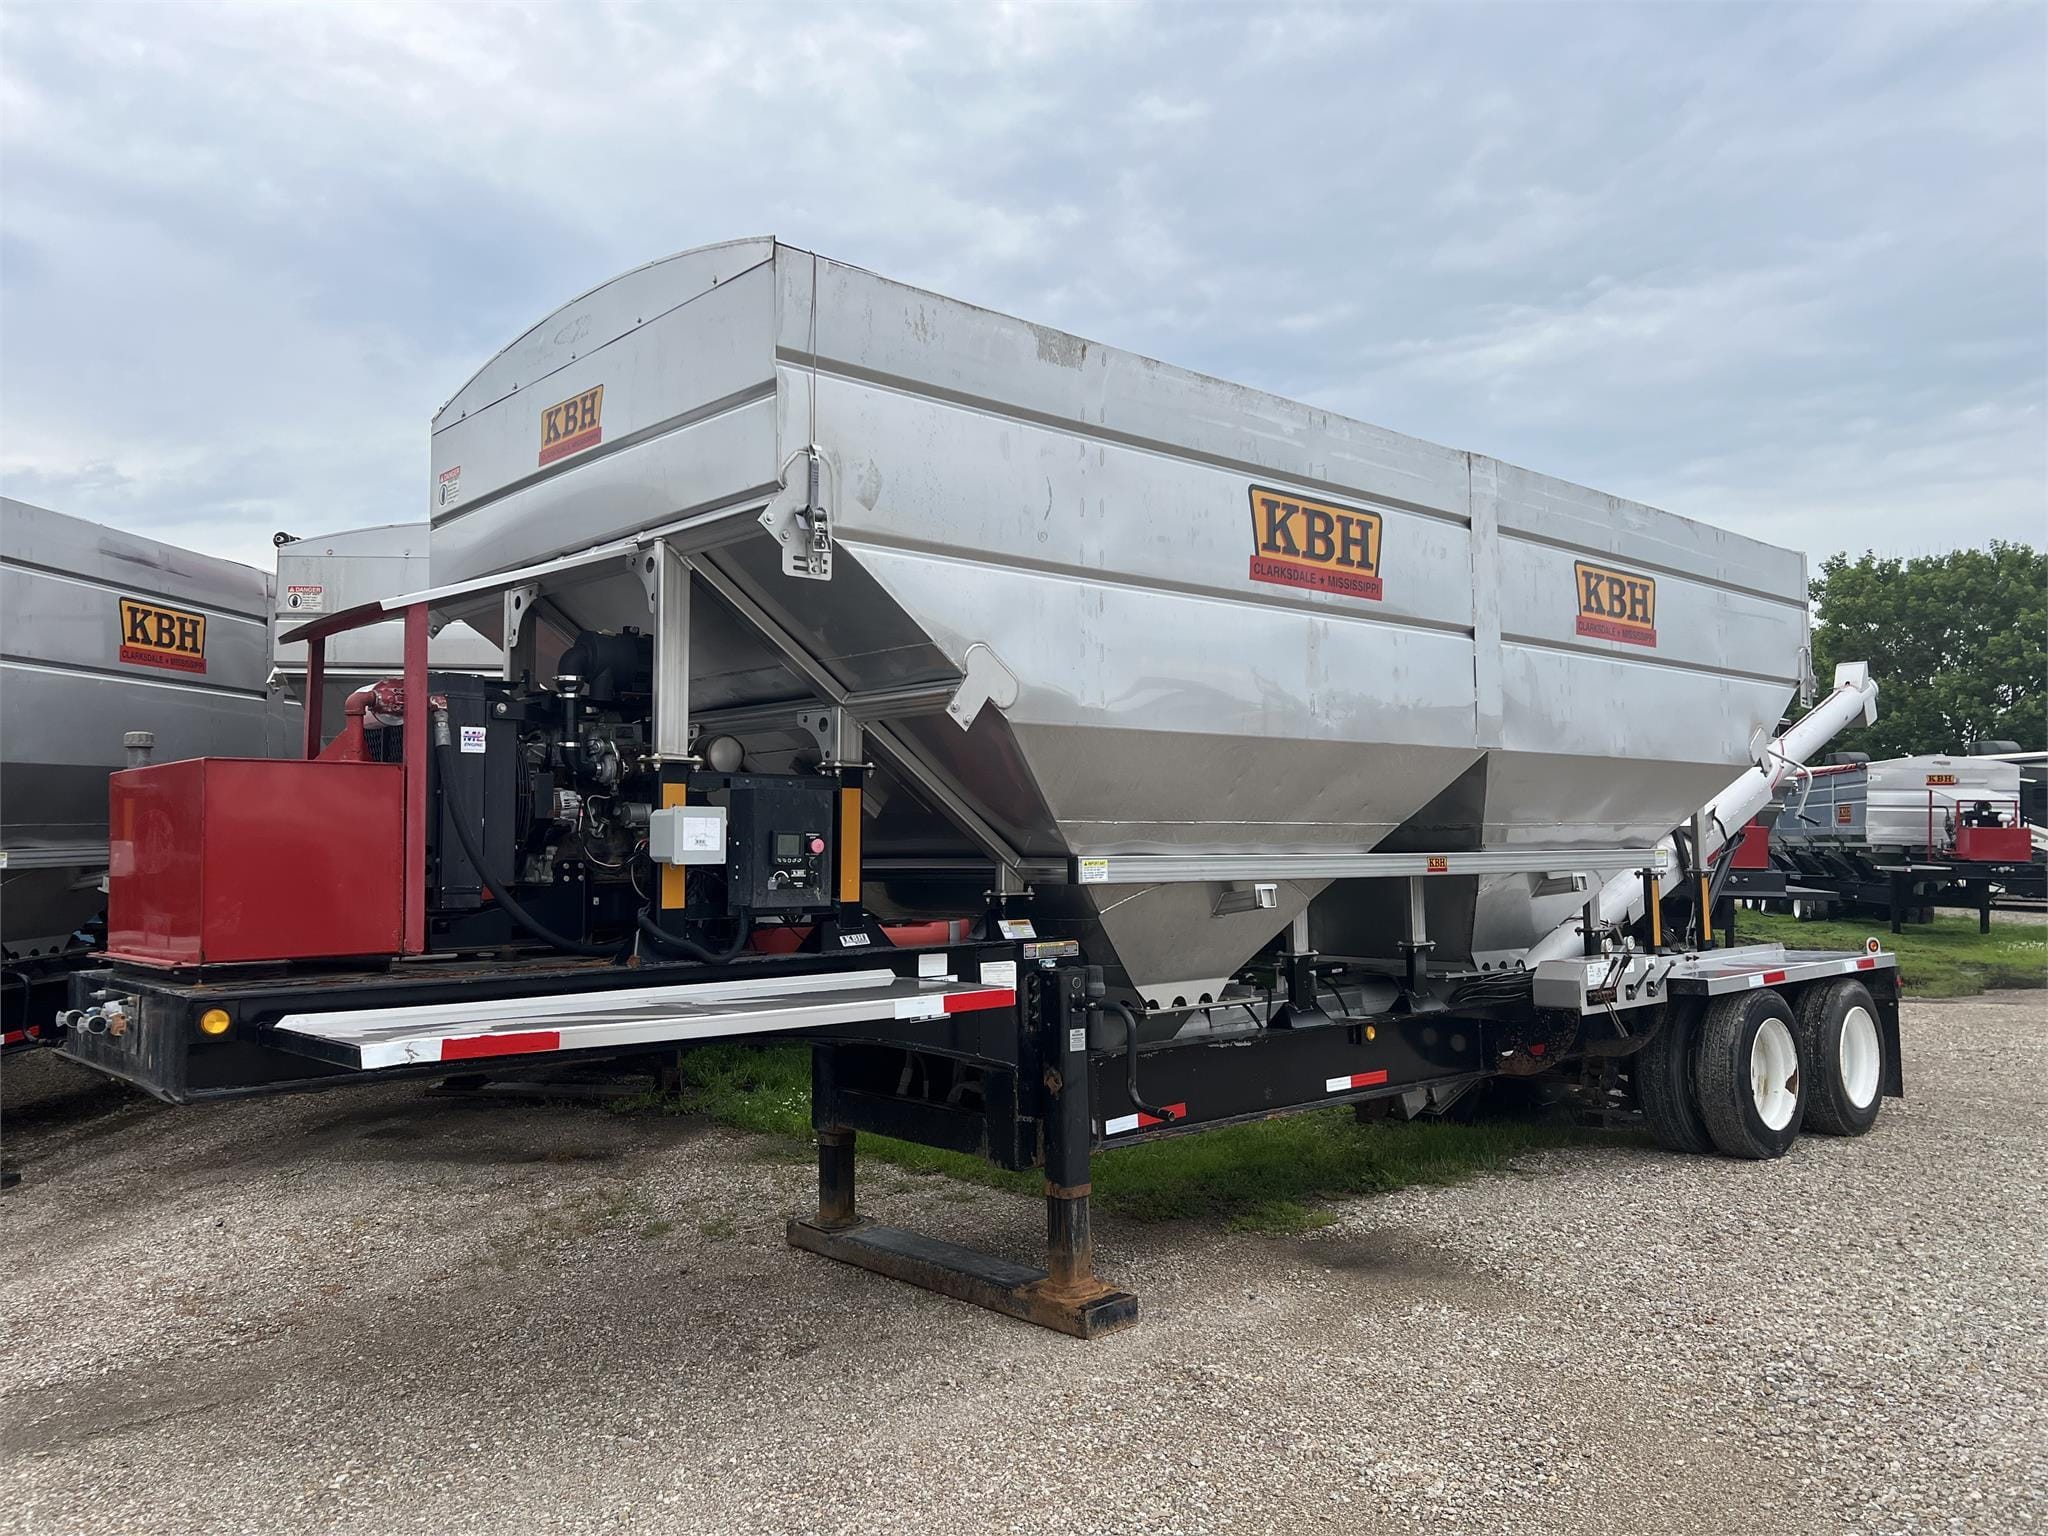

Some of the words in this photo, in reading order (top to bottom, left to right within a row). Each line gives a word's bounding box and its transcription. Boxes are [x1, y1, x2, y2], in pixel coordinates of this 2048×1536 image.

[544, 390, 598, 446] KBH
[1261, 498, 1374, 570] KBH
[1253, 562, 1317, 584] CLARKSDALE
[1327, 575, 1380, 594] MISSISSIPPI
[1582, 570, 1651, 624] KBH
[127, 605, 201, 654] KBH
[1578, 621, 1616, 636] CLARKSDALE
[1622, 628, 1654, 643] MISSISSIPPI
[122, 650, 163, 663] CLARKSDALE
[170, 657, 205, 671] MISSISSIPPI
[1927, 775, 1953, 783] KBH
[1429, 858, 1446, 867] KBH
